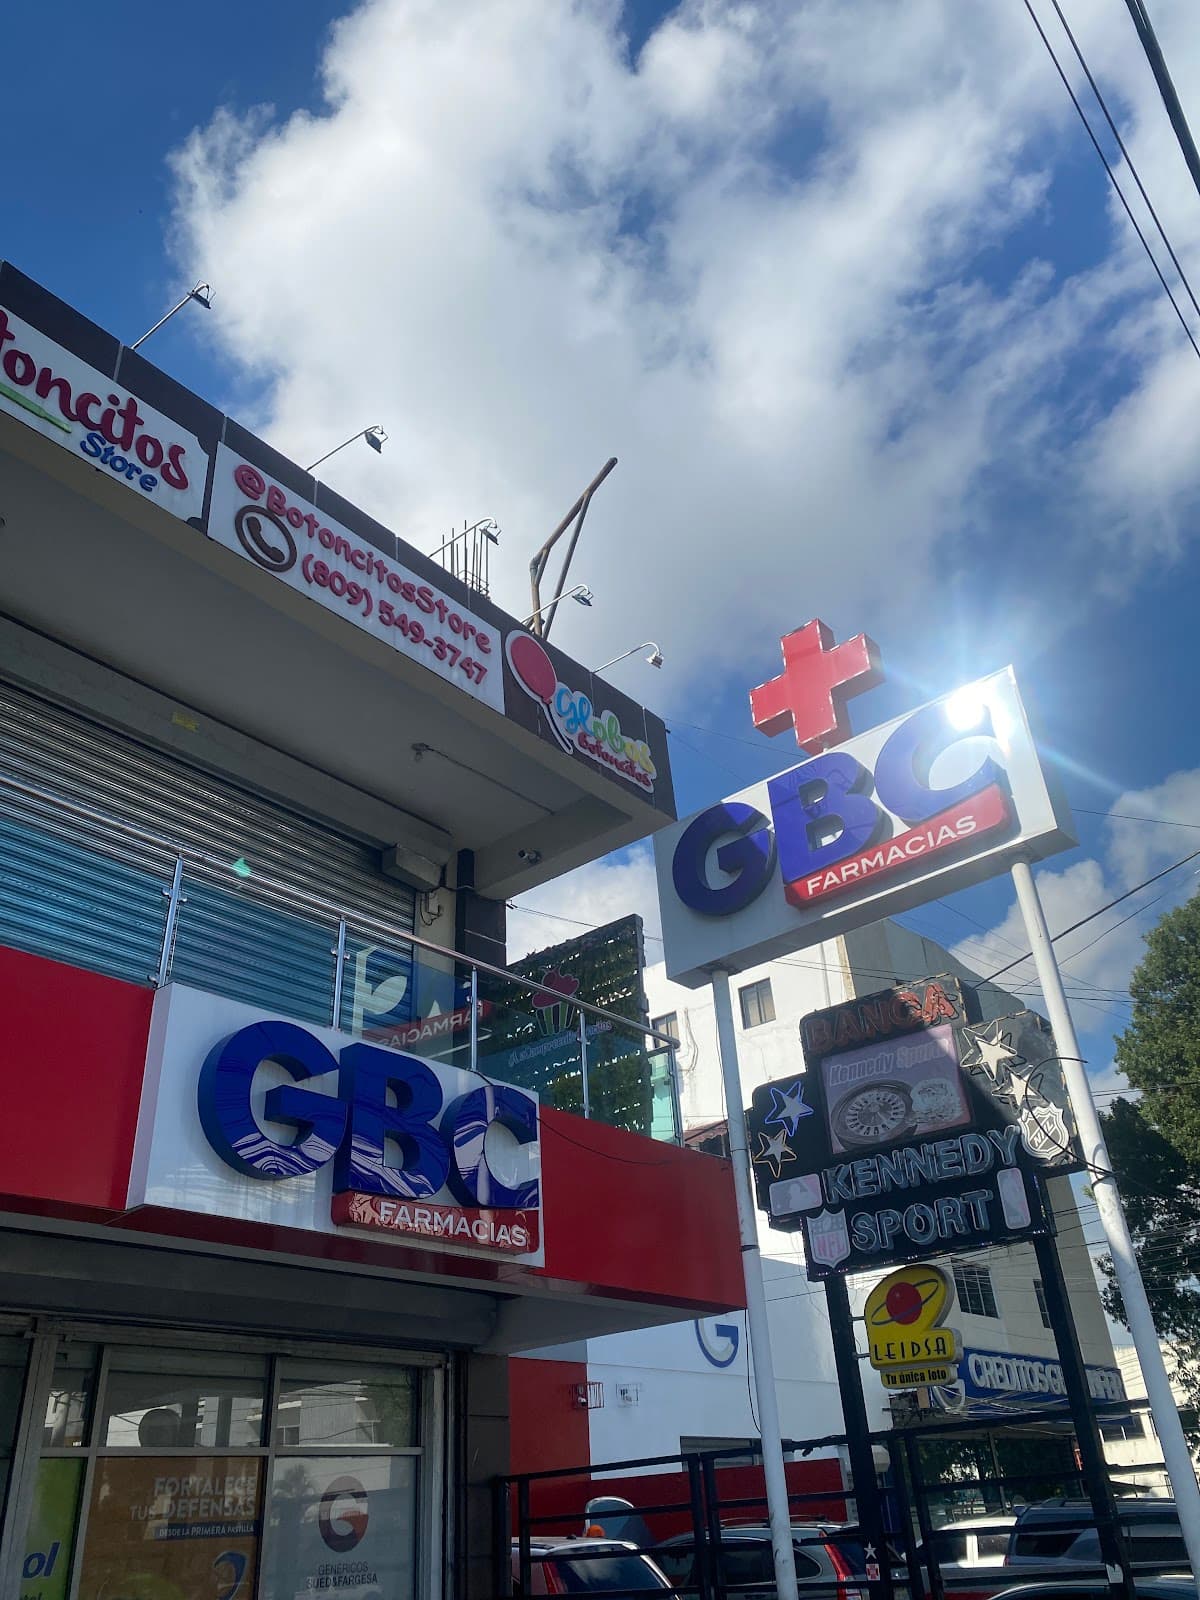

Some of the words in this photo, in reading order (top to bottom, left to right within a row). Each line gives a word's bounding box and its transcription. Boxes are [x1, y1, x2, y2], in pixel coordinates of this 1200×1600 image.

[80, 432, 158, 493] Store
[234, 464, 492, 655] @BotoncitosStore
[302, 553, 374, 617] (809)
[378, 599, 488, 685] 549-3747
[672, 700, 1012, 916] GBC
[806, 815, 978, 896] FARMACIAS
[805, 982, 960, 1051] BANCA
[829, 1051, 894, 1088] Kennedy
[198, 1021, 540, 1208] GBC
[822, 1124, 1021, 1204] KENNEDY
[379, 1201, 529, 1248] FARMACIAS
[851, 1188, 995, 1250] SPORT
[873, 1336, 947, 1361] LEIDSA
[885, 1373, 897, 1385] Tu
[927, 1369, 947, 1381] loto
[129, 1504, 157, 1521] TUS
[162, 1496, 255, 1520] DEFENSAS
[154, 1474, 257, 1497] FORTALECE
[191, 1525, 226, 1537] PRIMERA
